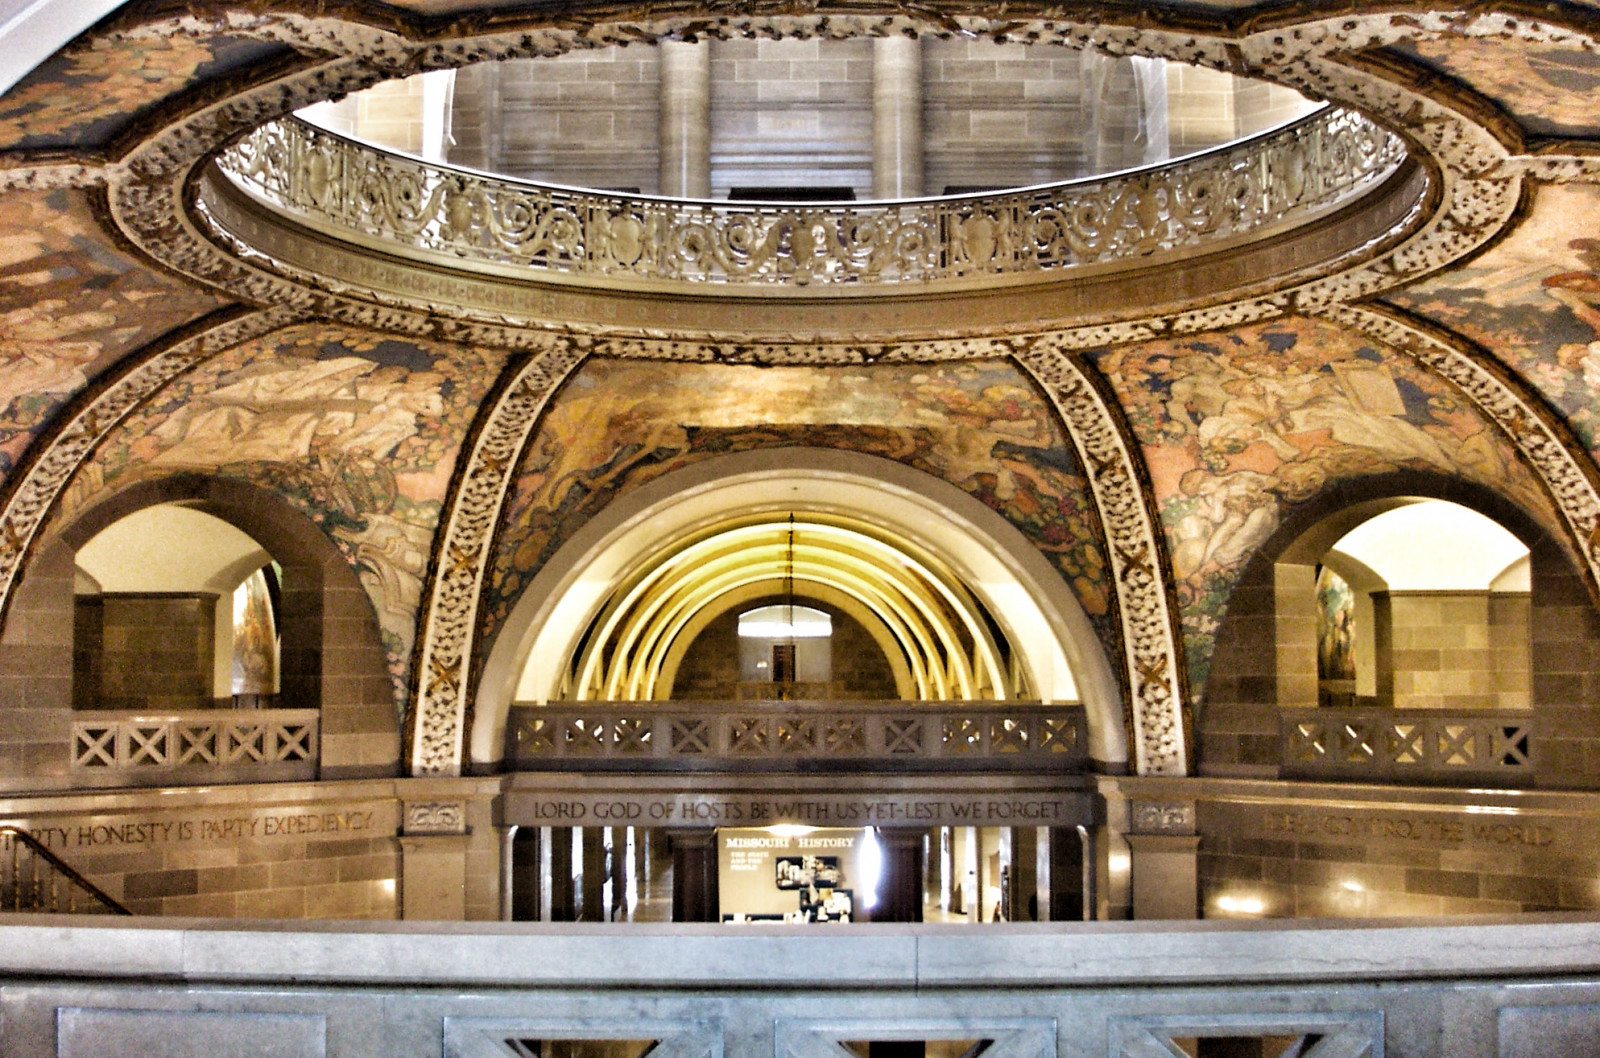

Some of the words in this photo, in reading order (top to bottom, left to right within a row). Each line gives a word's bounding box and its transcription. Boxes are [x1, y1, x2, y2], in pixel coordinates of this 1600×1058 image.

[534, 801, 586, 820] LORD
[593, 801, 641, 820] GOD
[649, 801, 673, 820] OF
[682, 801, 744, 820] HOSTS
[751, 801, 770, 820] BE
[775, 801, 829, 820] WITH
[836, 801, 858, 820] US
[950, 801, 981, 820] WE
[987, 801, 1061, 820] FORGET
[78, 822, 173, 846] HONESTY
[179, 819, 193, 840] IS
[200, 816, 260, 840] PARTY
[264, 810, 374, 836] EXPEDIENCY
[1471, 821, 1553, 847] WORLD
[726, 838, 789, 849] MISSOURI
[798, 838, 855, 848] HISTORY
